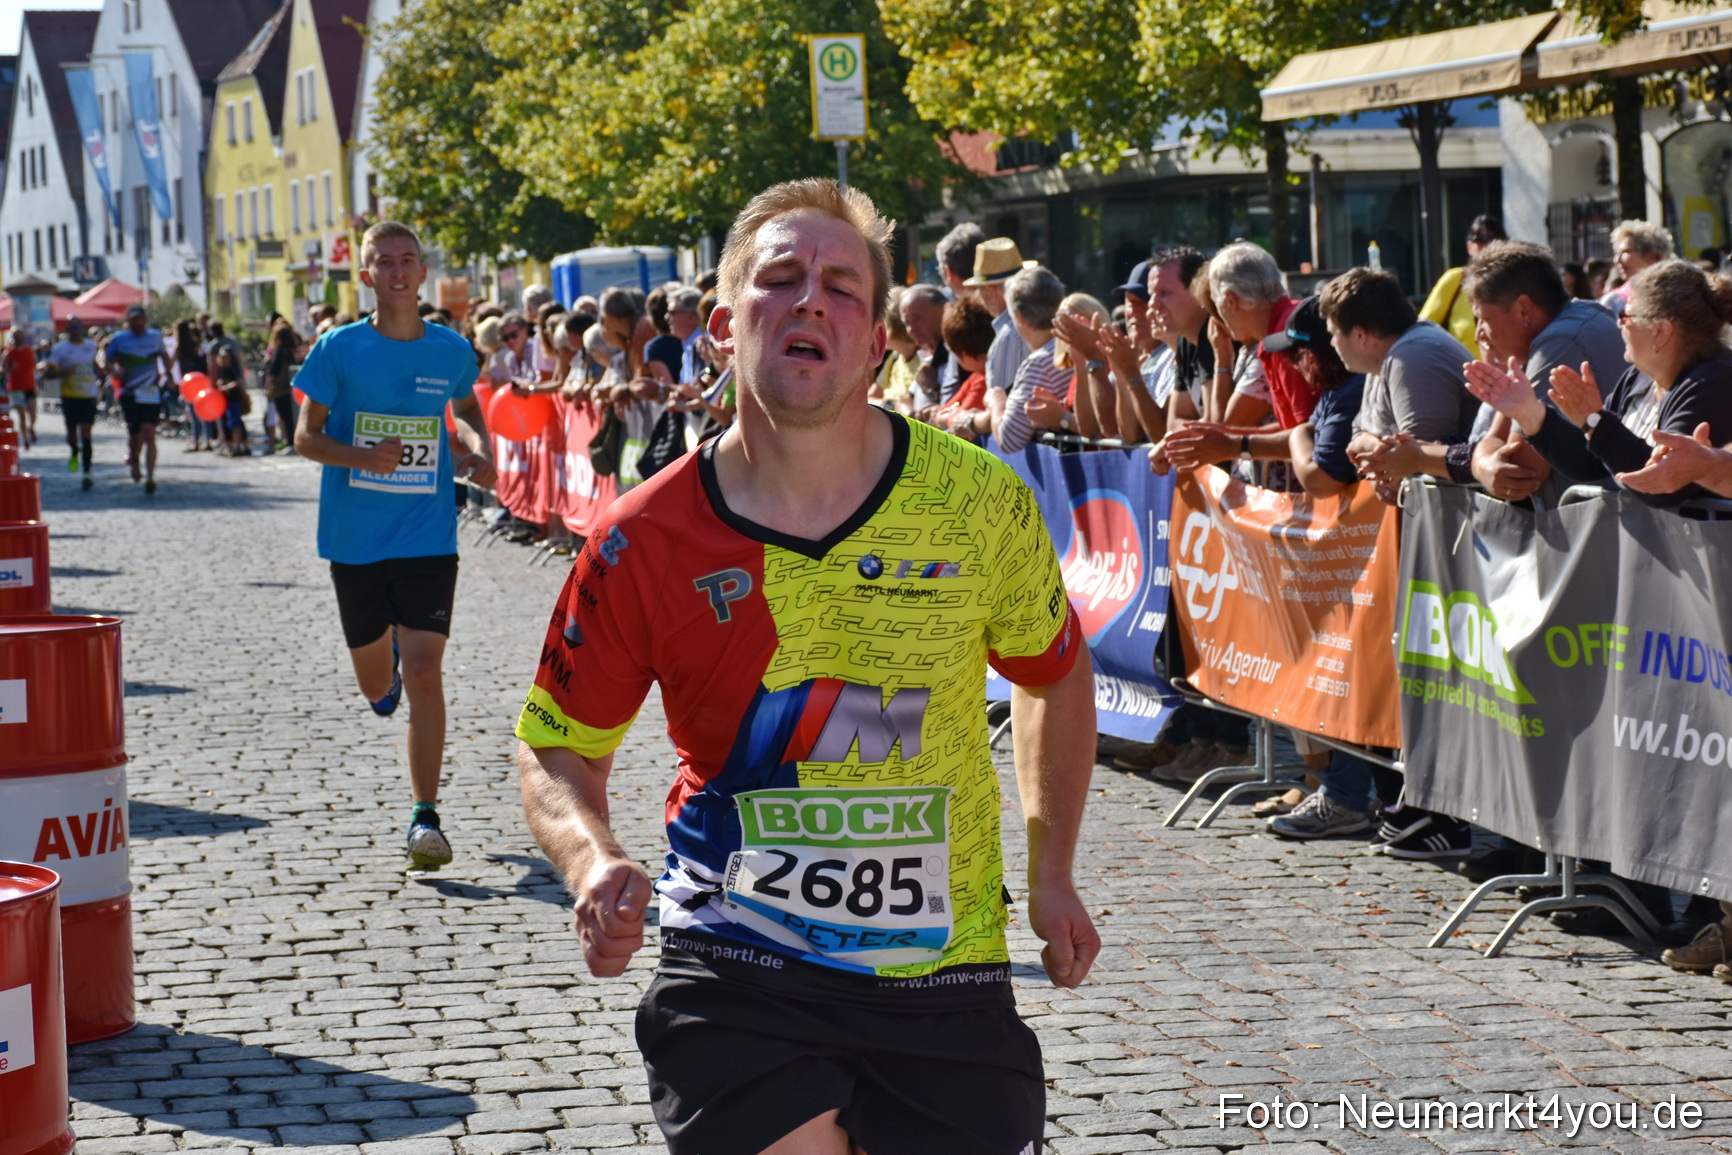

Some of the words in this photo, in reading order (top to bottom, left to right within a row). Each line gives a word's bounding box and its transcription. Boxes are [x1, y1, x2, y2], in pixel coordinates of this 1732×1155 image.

[362, 417, 433, 437] BOCK
[1339, 523, 1379, 537] Partner
[1062, 531, 1138, 612] hervis
[1296, 568, 1334, 586] Projekte
[855, 584, 886, 594] PARTL
[887, 587, 940, 598] NEUMARKT
[1639, 630, 1732, 697] INDUS
[1398, 668, 1465, 706] inspired
[754, 796, 933, 841] BOCK
[752, 849, 924, 918] 2685
[783, 912, 918, 949] PETER
